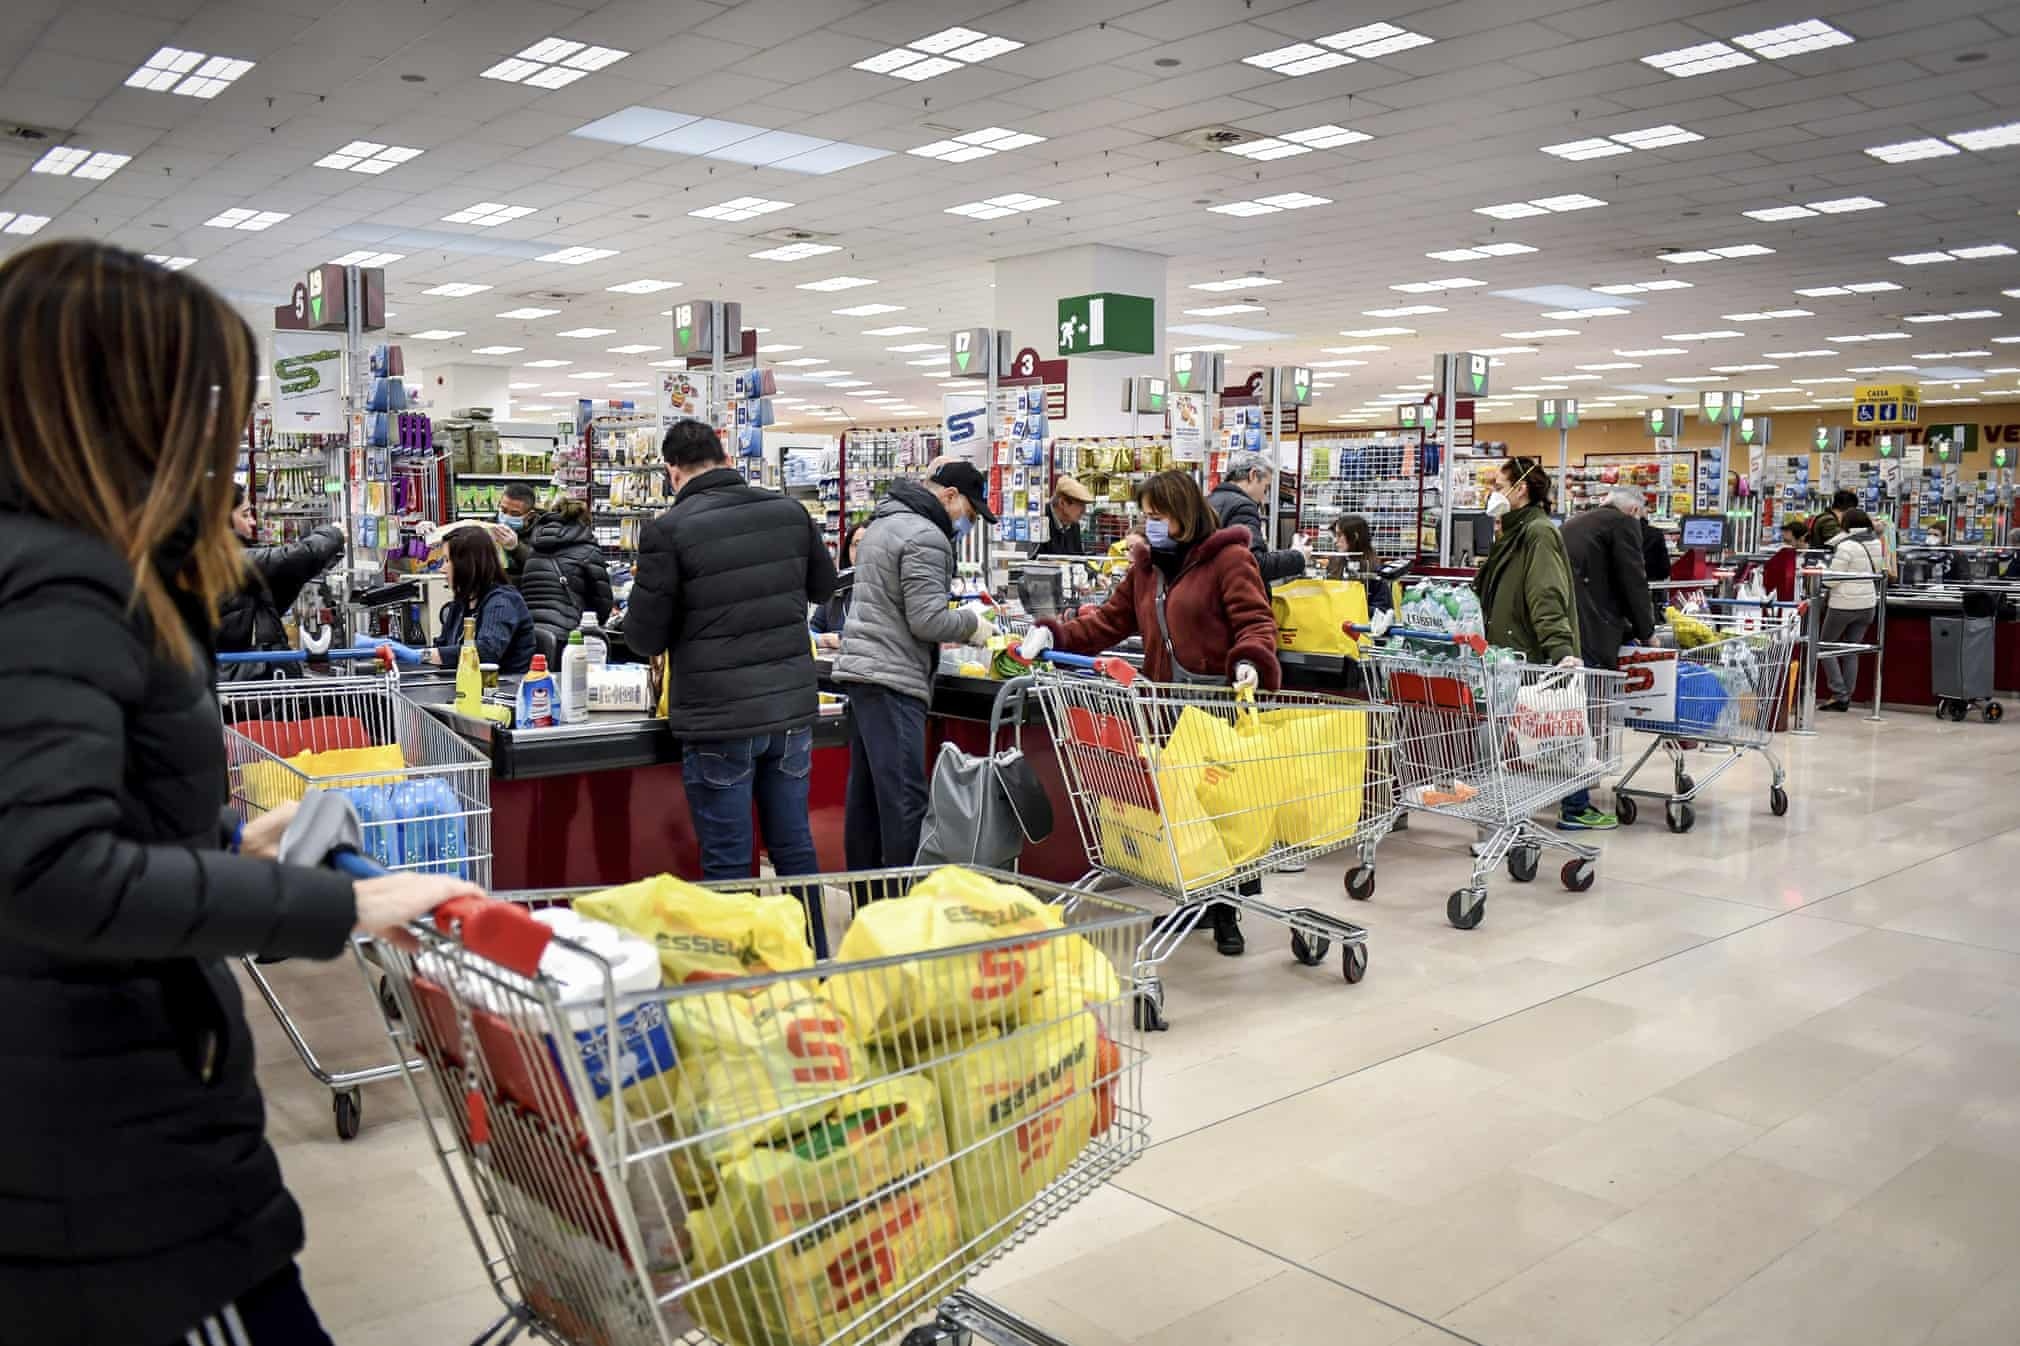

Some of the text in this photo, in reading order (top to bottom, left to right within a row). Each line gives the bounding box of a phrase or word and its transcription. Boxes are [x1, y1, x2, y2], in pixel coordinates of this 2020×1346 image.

[295, 289, 305, 320] 5
[675, 305, 692, 328] 18
[955, 332, 970, 352] 17
[1021, 354, 1034, 375] 3
[1252, 378, 1263, 396] 2
[786, 1017, 852, 1084] S
